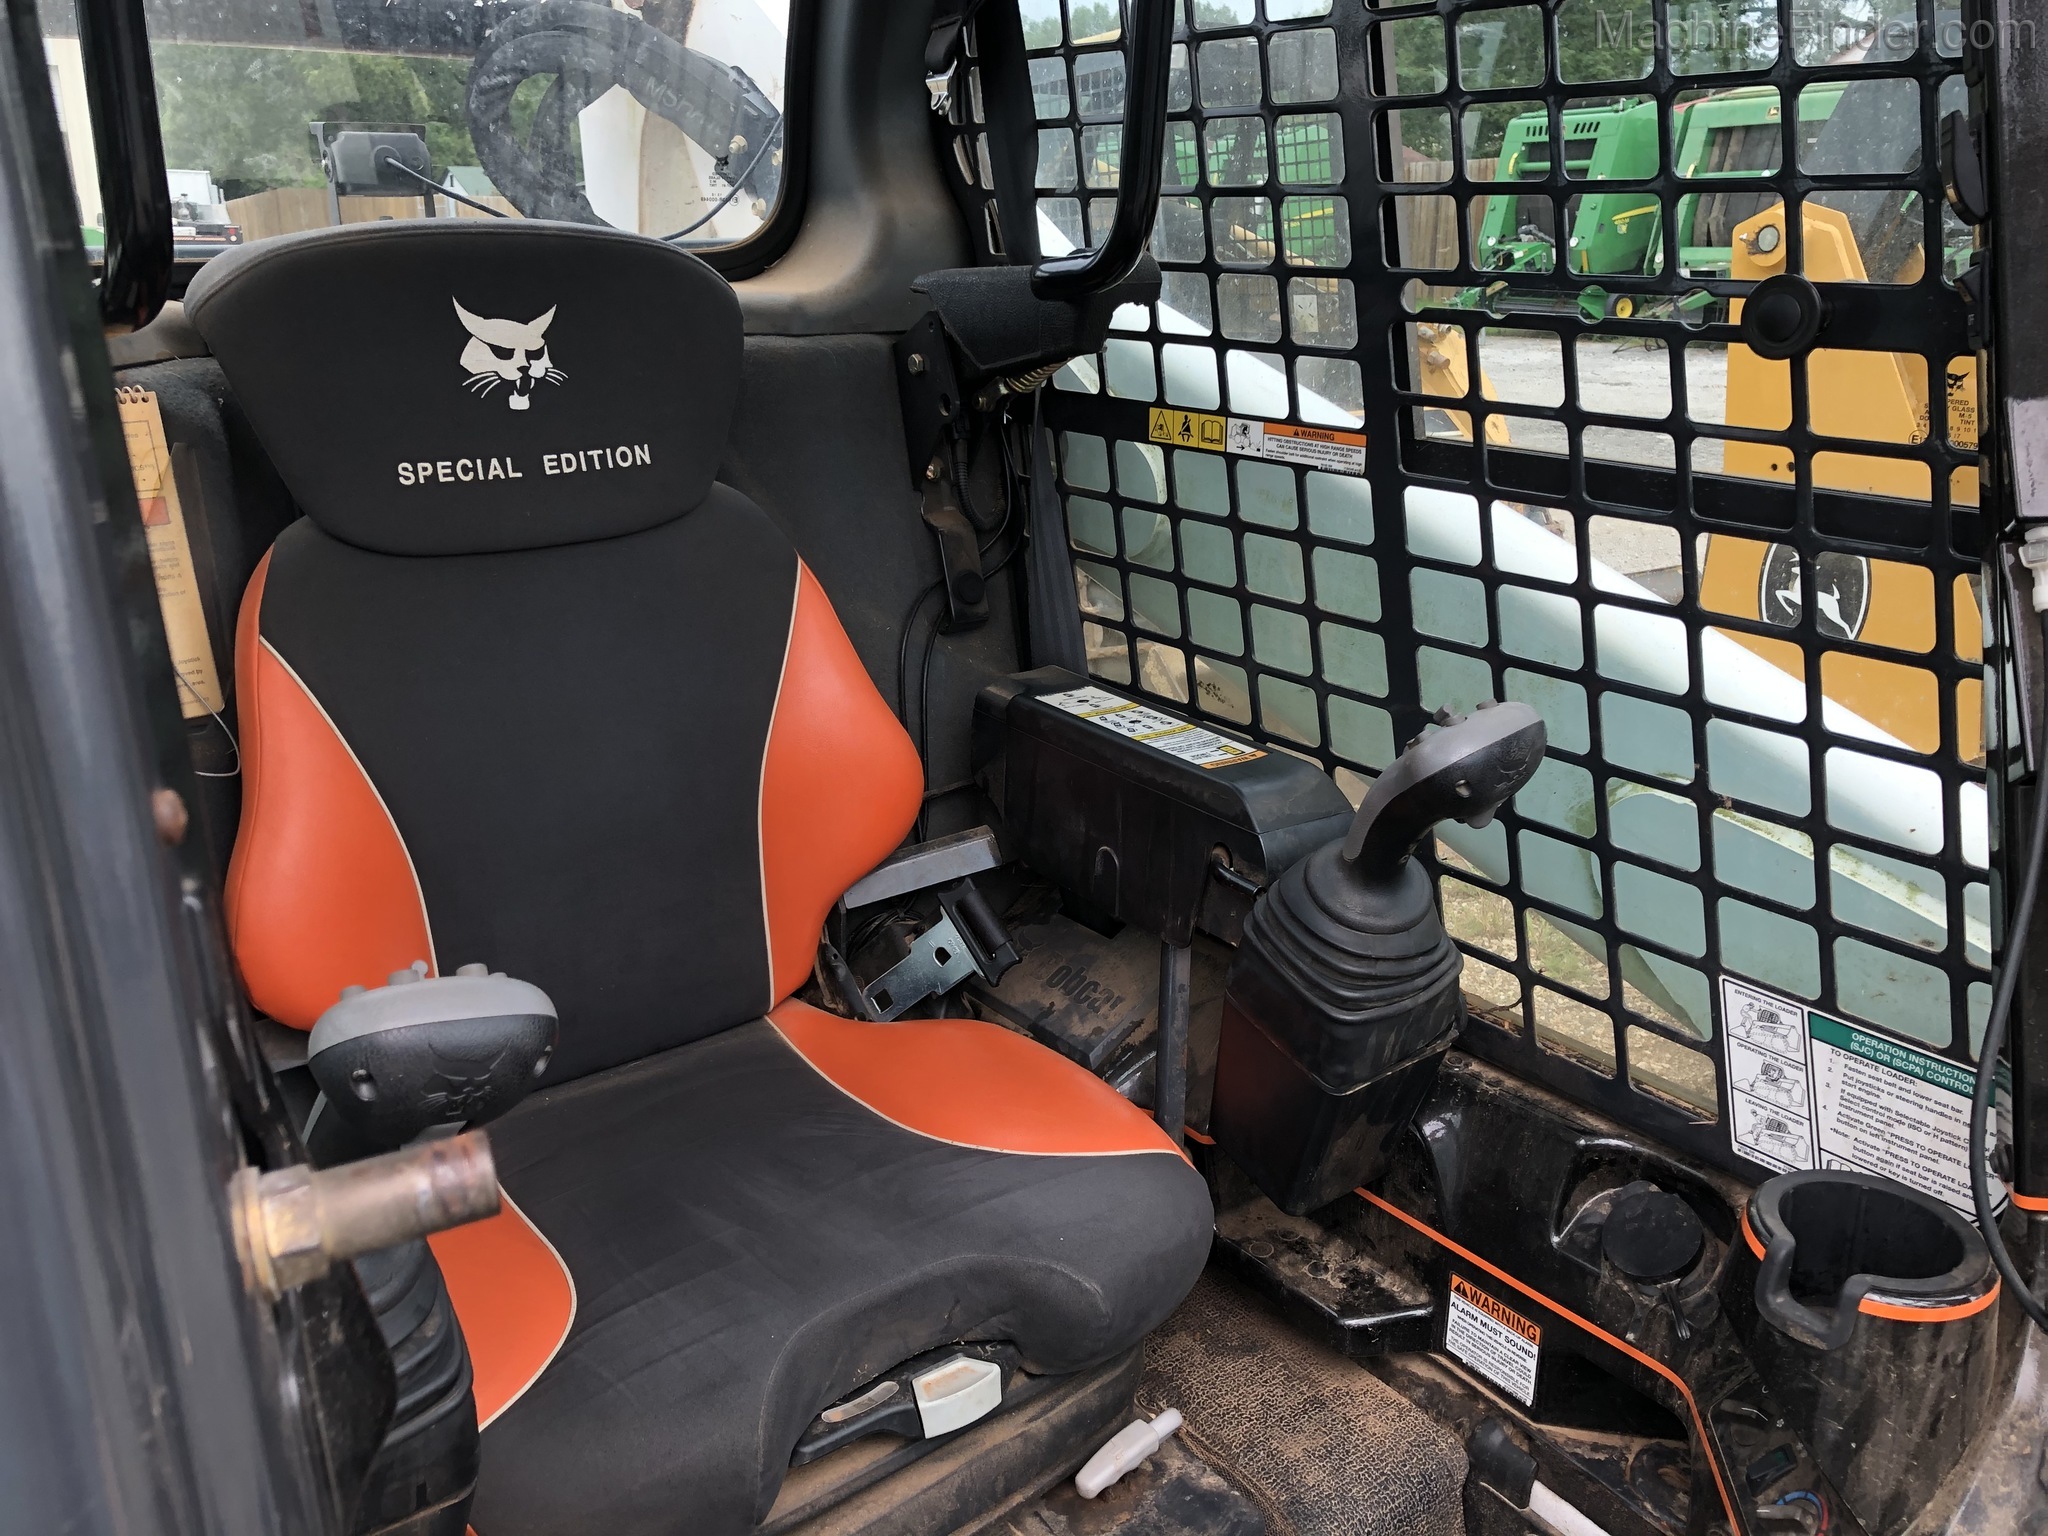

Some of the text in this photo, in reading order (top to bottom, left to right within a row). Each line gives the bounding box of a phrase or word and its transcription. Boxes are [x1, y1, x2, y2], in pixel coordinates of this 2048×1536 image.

[1301, 430, 1334, 441] WARNING
[397, 444, 651, 485] SPECIAL EDITION
[1734, 988, 1798, 1017] ENTERING THE LOADER
[1736, 1041, 1804, 1073] OPERATING THE LOADER
[1850, 1040, 1874, 1058] (SJC)
[1876, 1050, 1890, 1064] OR
[1892, 1056, 1924, 1077] (SCPA)
[1852, 1032, 1910, 1061] OPERATION
[1830, 1048, 1918, 1088] TO OPERATE LOADER:
[1841, 1079, 1857, 1090] start
[1844, 1063, 1866, 1078] Fasten
[1868, 1073, 1882, 1084] seat
[1884, 1079, 1897, 1089] belt
[1898, 1084, 1911, 1095] and
[1913, 1090, 1932, 1103] lower
[1934, 1098, 1949, 1110] seat
[1745, 1097, 1804, 1127] LEAVING THE LOADER
[1839, 1102, 1874, 1121] instrument
[1843, 1072, 1854, 1082] Put
[1855, 1077, 1885, 1095] joysticks
[1896, 1094, 1923, 1111] steering
[1925, 1105, 1952, 1121] handles
[1954, 1117, 1961, 1125] in
[1847, 1091, 1878, 1109] equipped
[1879, 1104, 1893, 1114] with
[1894, 1110, 1930, 1130] Selectable
[1932, 1125, 1962, 1143] Joystick
[1837, 1117, 1858, 1131] button
[1869, 1130, 1880, 1140] left
[1882, 1136, 1918, 1156] instrument
[1837, 1110, 1864, 1126] Activate
[1865, 1122, 1885, 1135] Green
[1916, 1142, 1926, 1152] TO
[1928, 1147, 1962, 1166] OPERATE
[1840, 1095, 1860, 1108] Select
[1862, 1104, 1885, 1118] control
[1887, 1114, 1906, 1126] mode
[1924, 1129, 1931, 1137] or
[1940, 1136, 1968, 1153] pattern)
[1852, 1153, 1878, 1169] lowered
[1880, 1165, 1887, 1173] or
[1888, 1168, 1900, 1179] key
[1910, 1177, 1932, 1191] turned
[1853, 1136, 1880, 1152] Activate
[1911, 1161, 1920, 1169] TO
[1922, 1166, 1956, 1184] OPERATE
[1853, 1145, 1874, 1159] button
[1876, 1155, 1894, 1168] again
[1902, 1166, 1917, 1176] seat
[1918, 1173, 1929, 1182] bar
[1939, 1182, 1960, 1195] raised
[1451, 1300, 1478, 1324] ALARM
[1480, 1318, 1503, 1339] MUST
[1504, 1335, 1536, 1361] SOUND!
[1469, 1286, 1537, 1342] WARNING
[1452, 1318, 1470, 1333] FAILURE
[1471, 1330, 1476, 1338] TO
[1478, 1335, 1499, 1352] MAINTAIN
[1504, 1352, 1519, 1365] CLEAR
[1520, 1363, 1531, 1374] VIEW
[1456, 1327, 1465, 1336] THE
[1466, 1333, 1489, 1352] DIRECTION
[1497, 1354, 1514, 1368] TRAVEL
[1515, 1365, 1532, 1380] COULD
